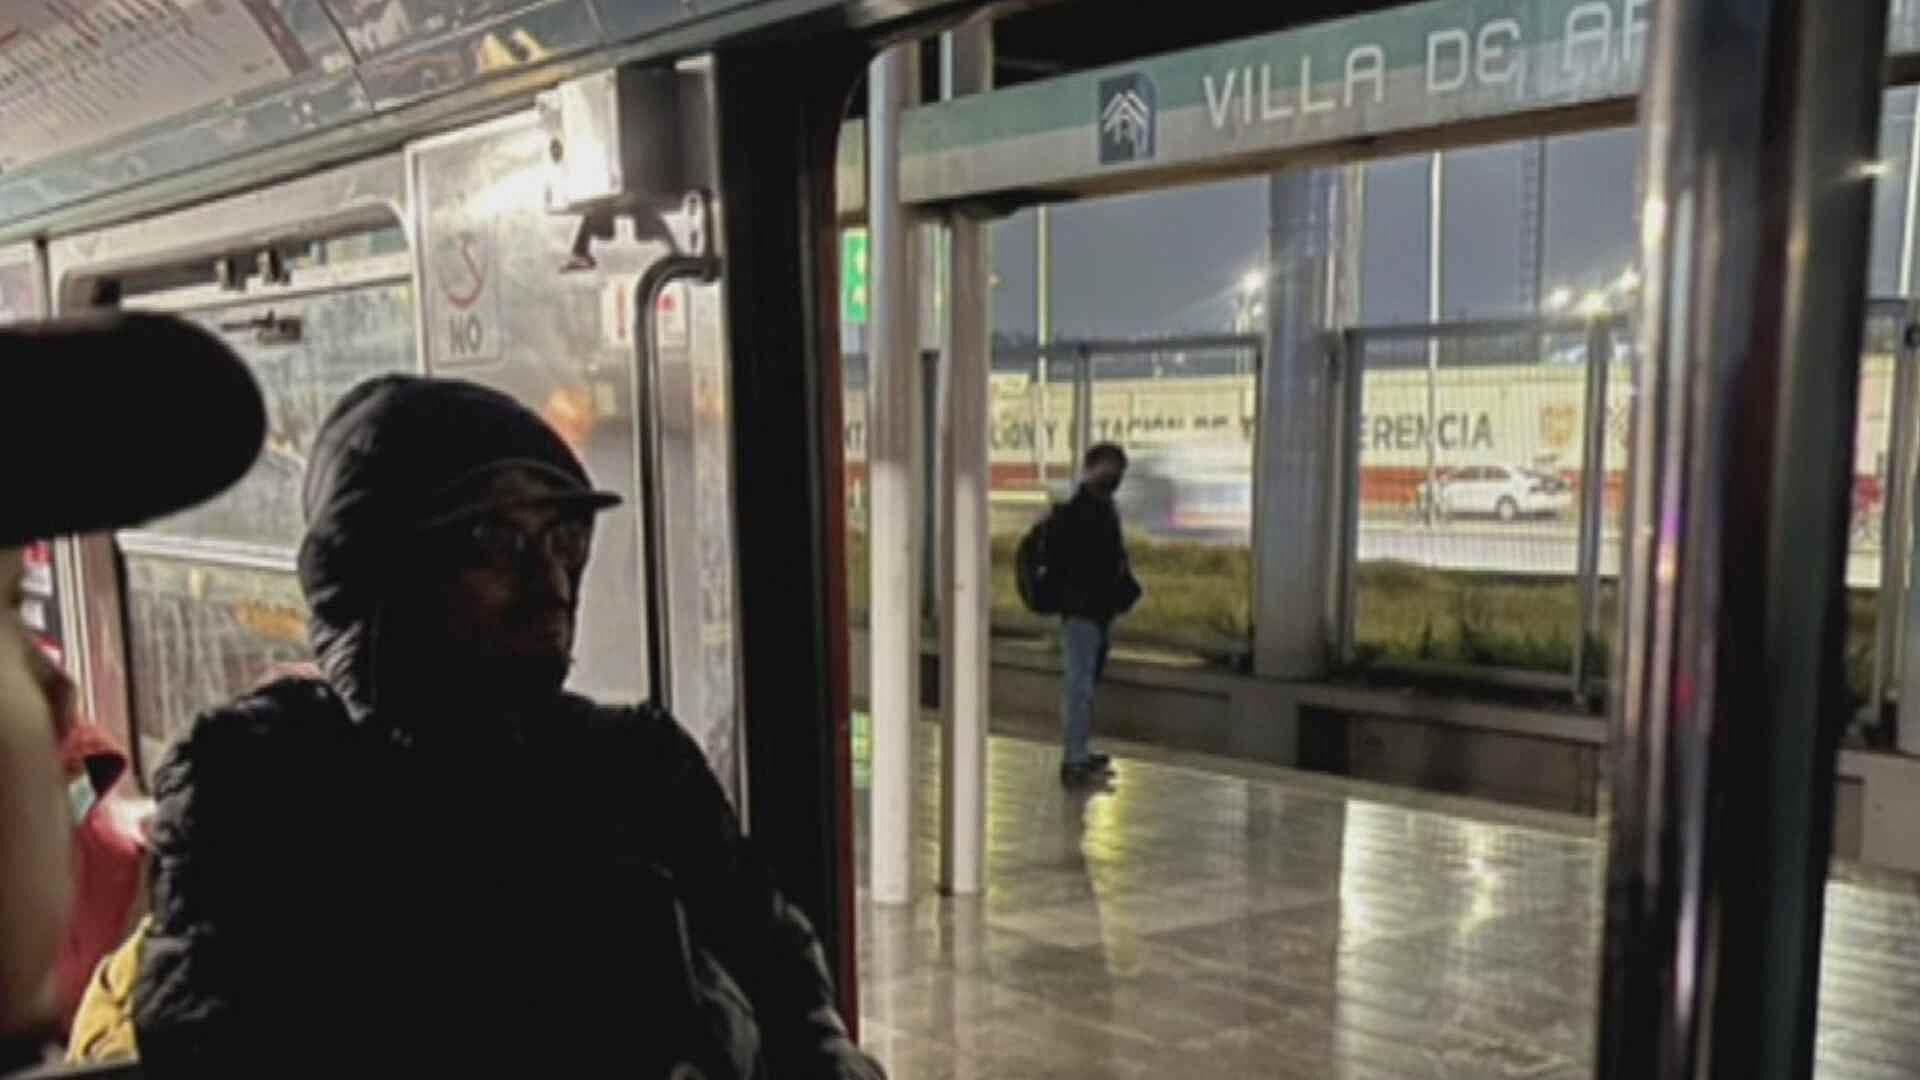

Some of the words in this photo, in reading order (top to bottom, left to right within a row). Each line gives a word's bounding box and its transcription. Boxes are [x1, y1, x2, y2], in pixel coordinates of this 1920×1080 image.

[1203, 43, 1386, 129] VILLA
[1425, 17, 1522, 93] DE
[449, 314, 482, 355] NO
